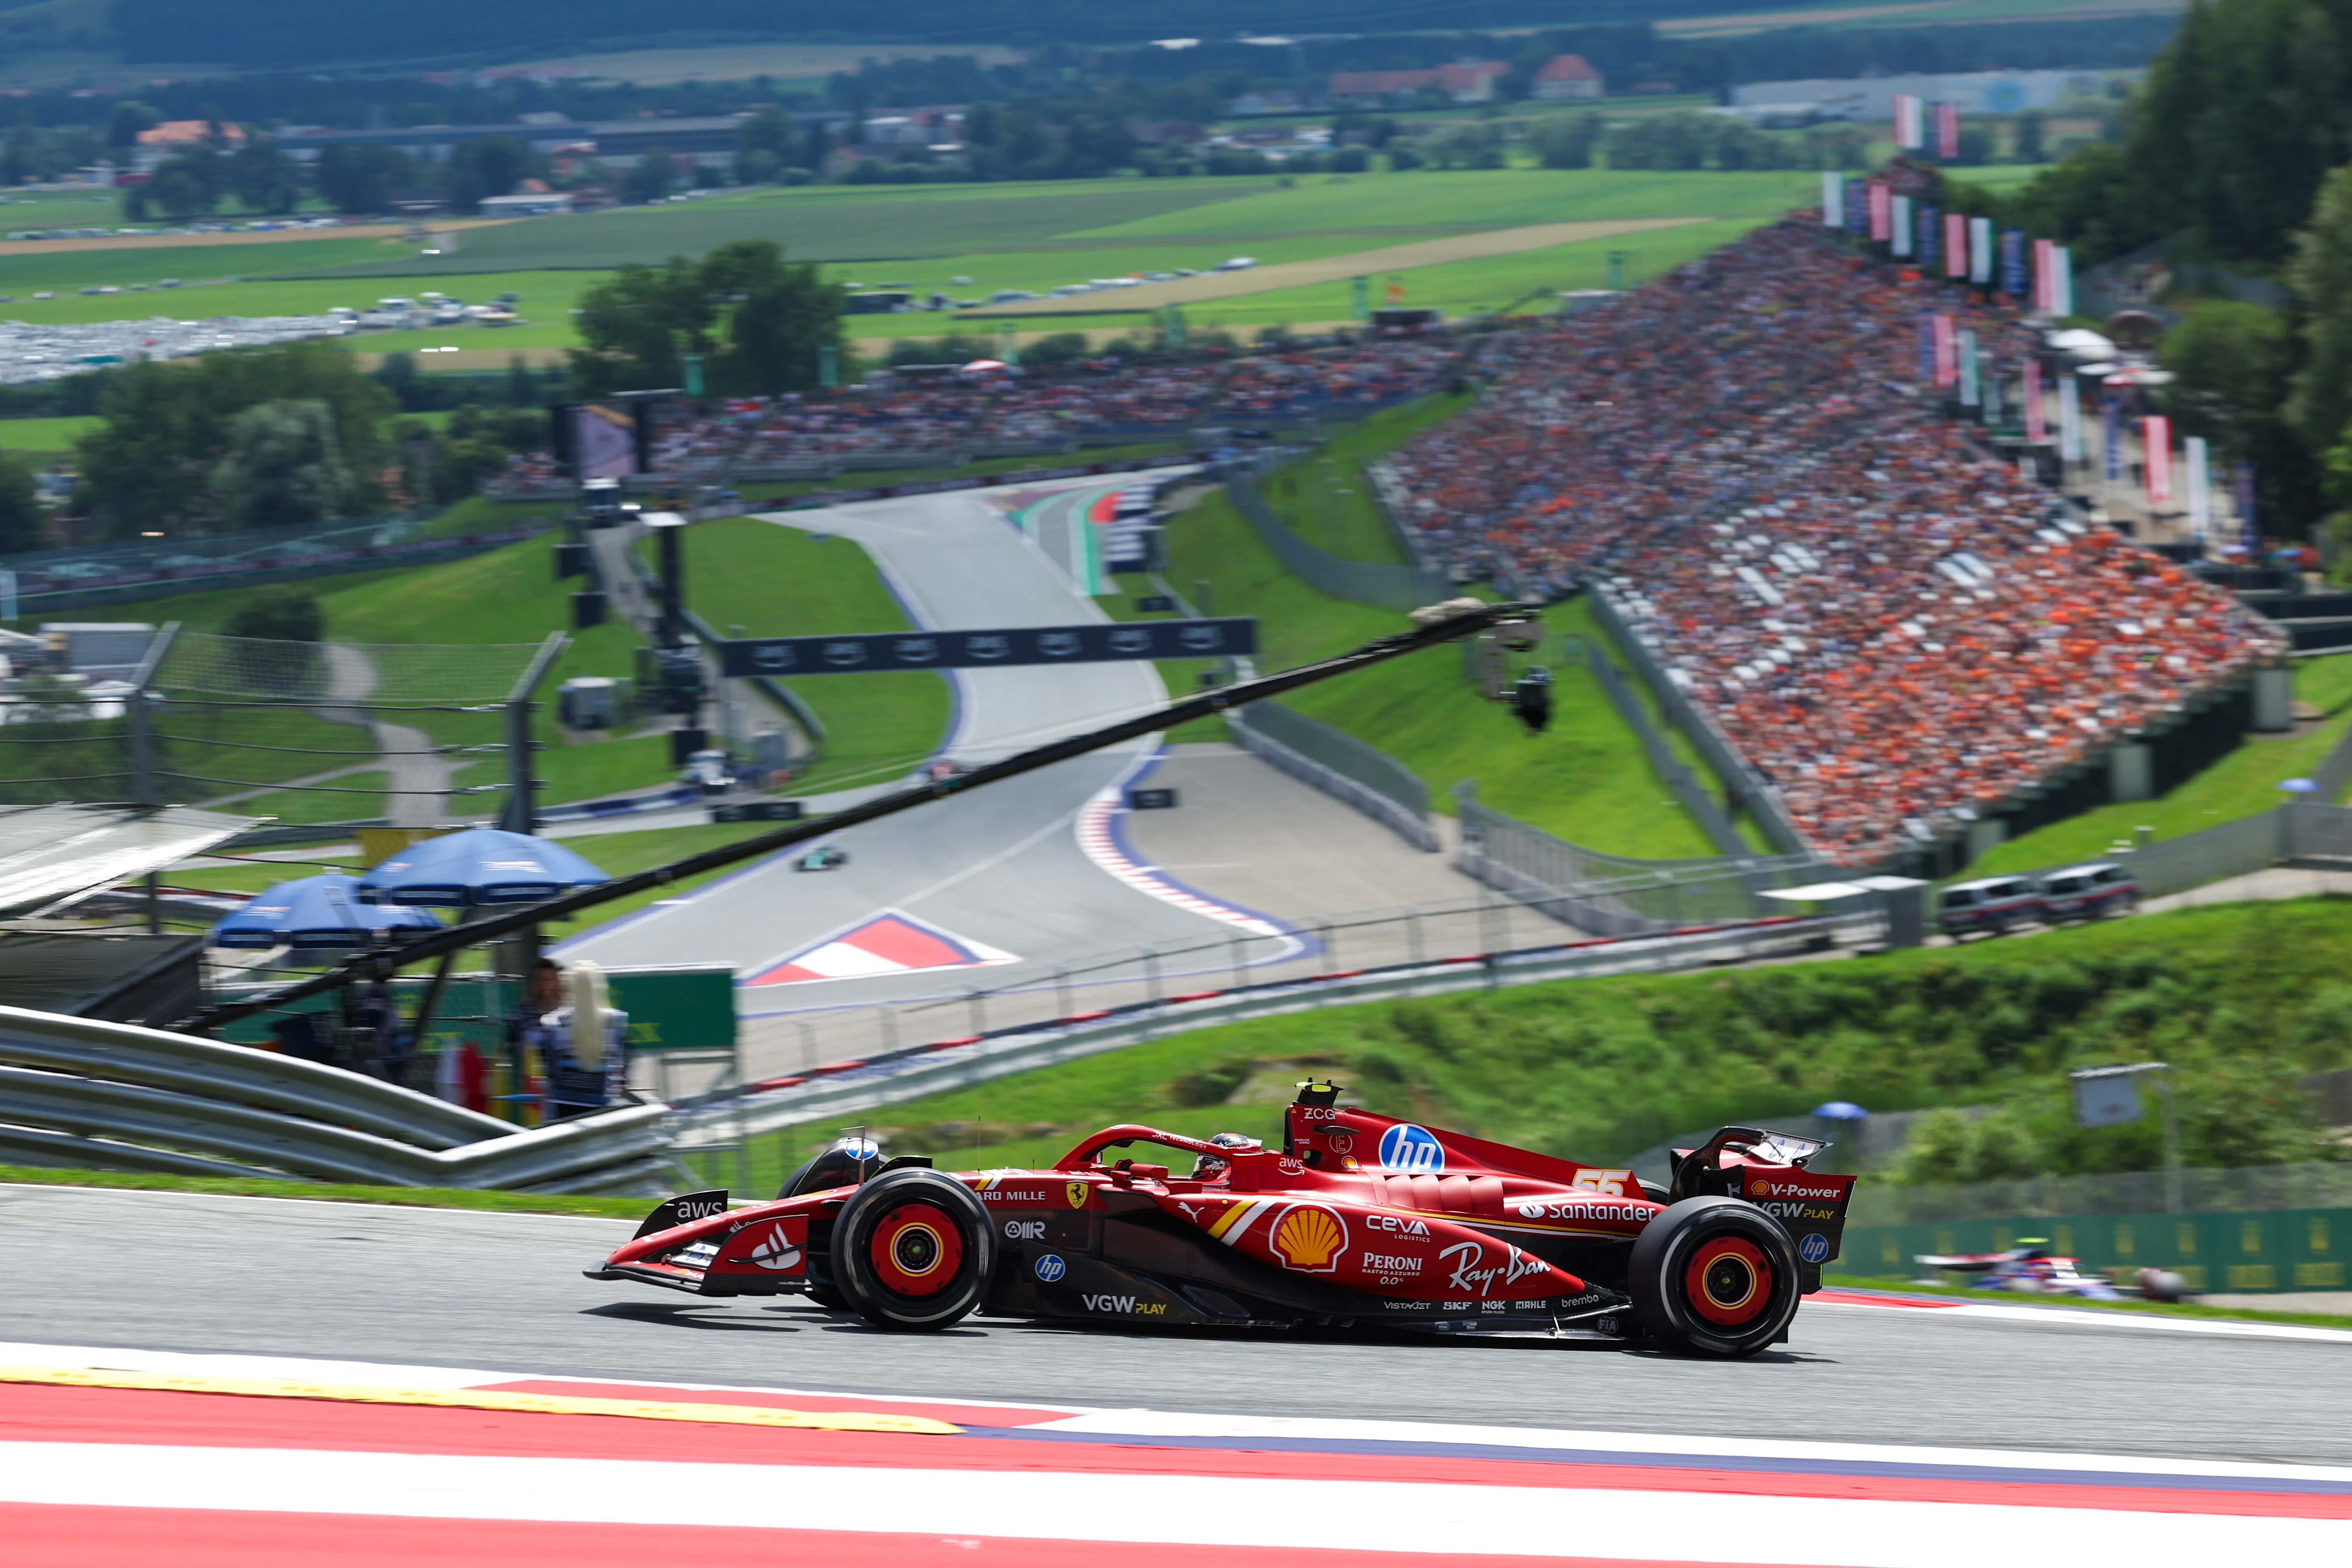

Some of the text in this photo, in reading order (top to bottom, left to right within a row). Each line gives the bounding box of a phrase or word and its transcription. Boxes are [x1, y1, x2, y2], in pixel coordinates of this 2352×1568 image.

[1169, 1135, 1207, 1149] TECHNOLOGY
[1389, 1124, 1436, 1173] hp
[1279, 1158, 1303, 1169] aws
[1572, 1169, 1631, 1196] 55
[975, 1191, 1046, 1200] ARD MILLE
[1771, 1184, 1840, 1198] V-Power
[677, 1201, 722, 1218] aws
[1548, 1202, 1656, 1221] Santander
[1804, 1209, 1834, 1220] PLAY
[1394, 1234, 1430, 1243] LOGISTICS
[1803, 1235, 1825, 1262] hp
[1039, 1255, 1062, 1281] hp
[1363, 1252, 1423, 1270] PERONI
[1082, 1294, 1167, 1314] VGW PLAY
[1443, 1301, 1472, 1310] SKF
[1482, 1301, 1506, 1310] NGK
[1515, 1300, 1546, 1309] MAHLE
[1562, 1294, 1599, 1308] brembo
[1599, 1319, 1616, 1330] FIA
